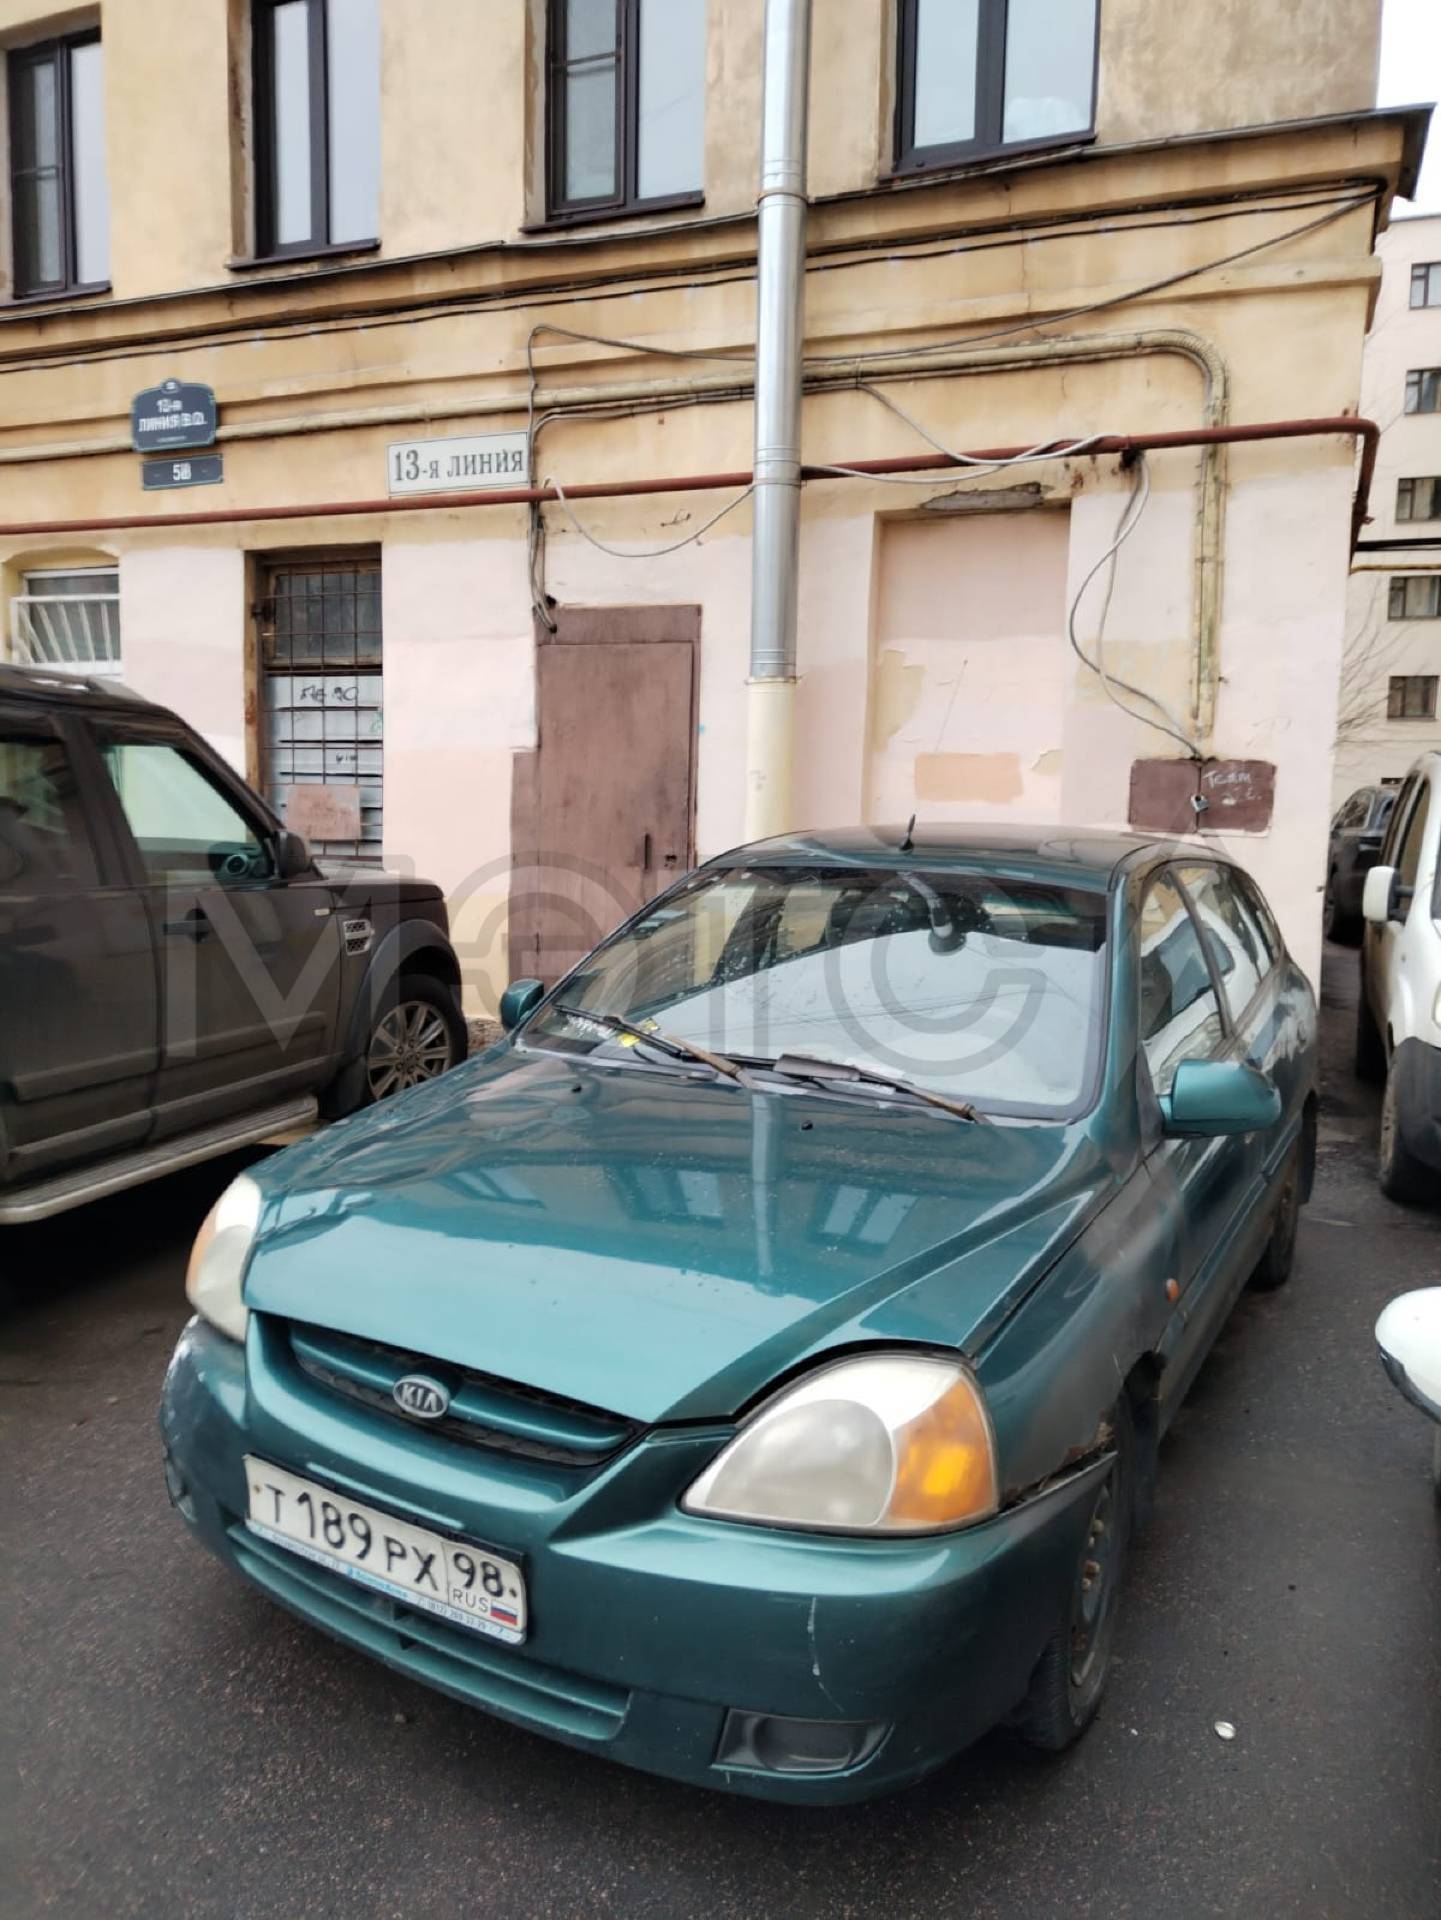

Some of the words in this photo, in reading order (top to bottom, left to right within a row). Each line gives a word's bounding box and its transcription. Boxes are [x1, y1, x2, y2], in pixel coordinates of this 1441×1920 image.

[394, 449, 440, 481] 13-я
[401, 1383, 438, 1412] KIA
[452, 1551, 504, 1598] 98
[452, 1587, 489, 1614] RUS
